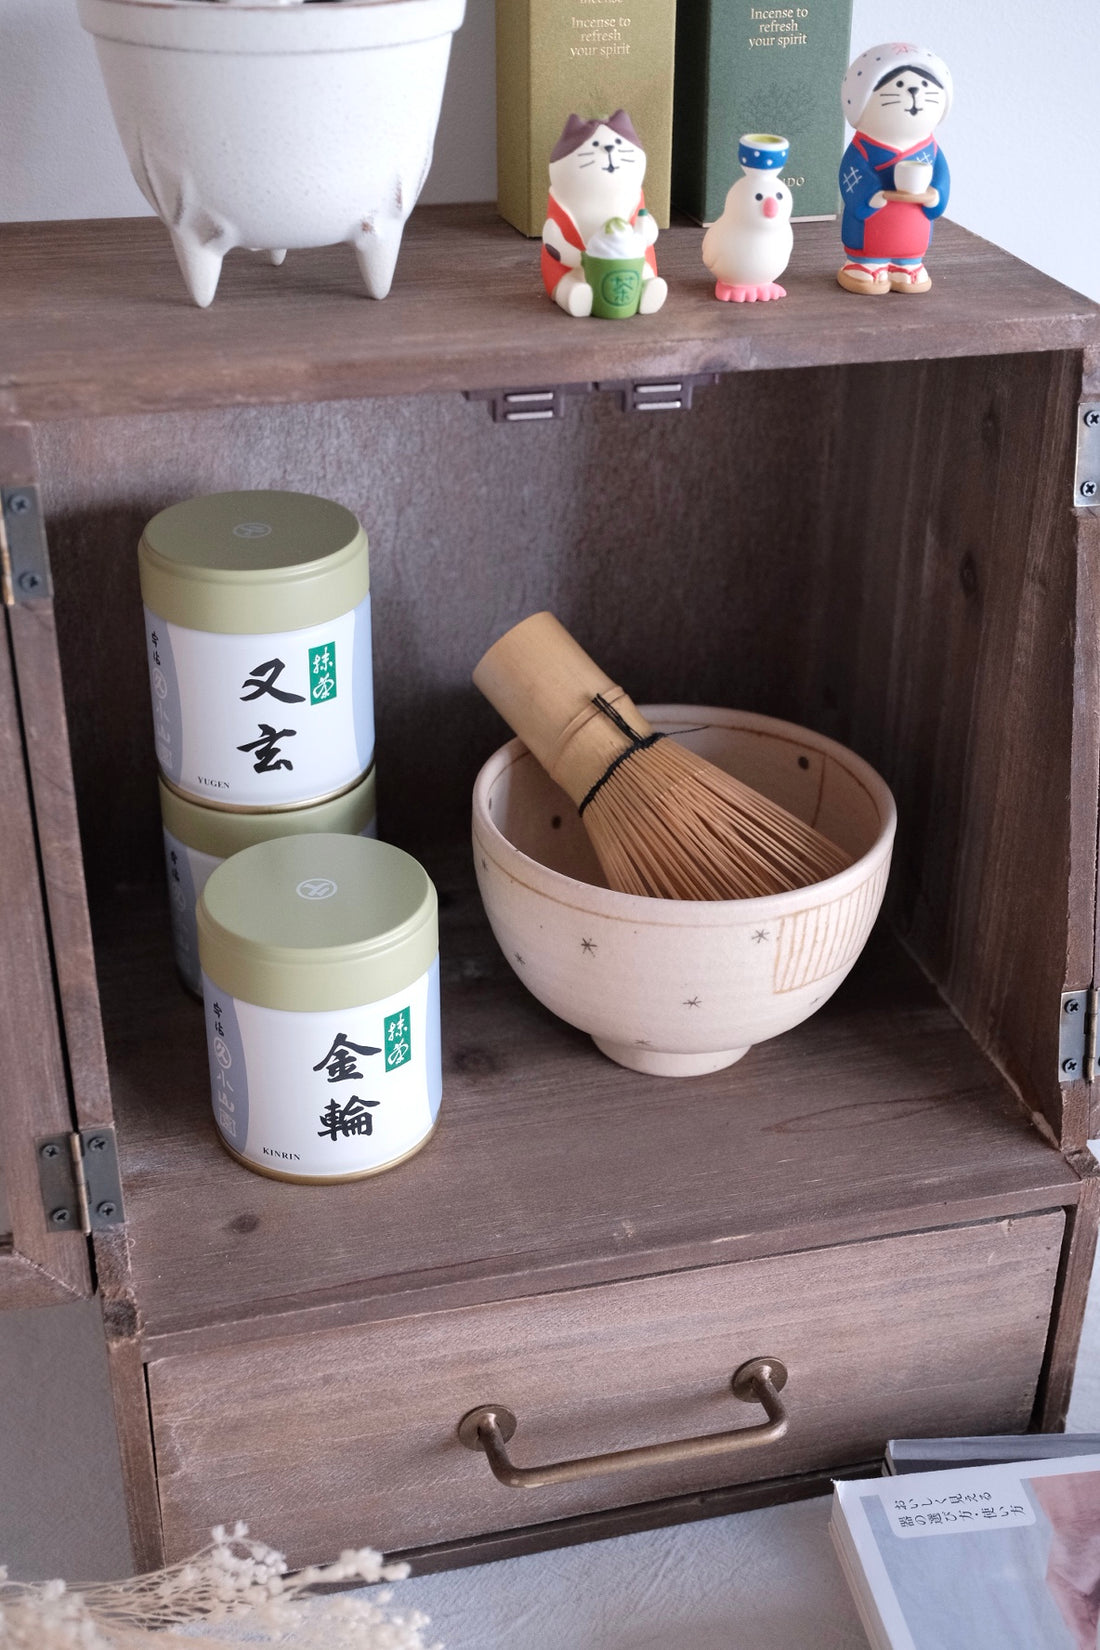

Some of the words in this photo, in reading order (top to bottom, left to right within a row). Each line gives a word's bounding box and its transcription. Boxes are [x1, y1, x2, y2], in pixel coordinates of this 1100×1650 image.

[750, 8, 794, 20] Incense
[796, 7, 809, 18] to
[571, 16, 616, 28] Incense
[619, 17, 632, 28] to
[759, 19, 798, 32] refresh
[580, 28, 622, 42] refresh
[748, 36, 775, 50] your
[777, 33, 808, 49] spirit
[570, 47, 598, 59] your
[600, 42, 631, 58] spirit
[236, 657, 307, 774] 又玄
[197, 776, 231, 789] YUGEN
[312, 1032, 382, 1142] 金輪
[262, 1147, 301, 1161] KINRIN
[895, 1492, 992, 1510] おいしく見える
[898, 1505, 1024, 1527] 器の選び方・使い方
